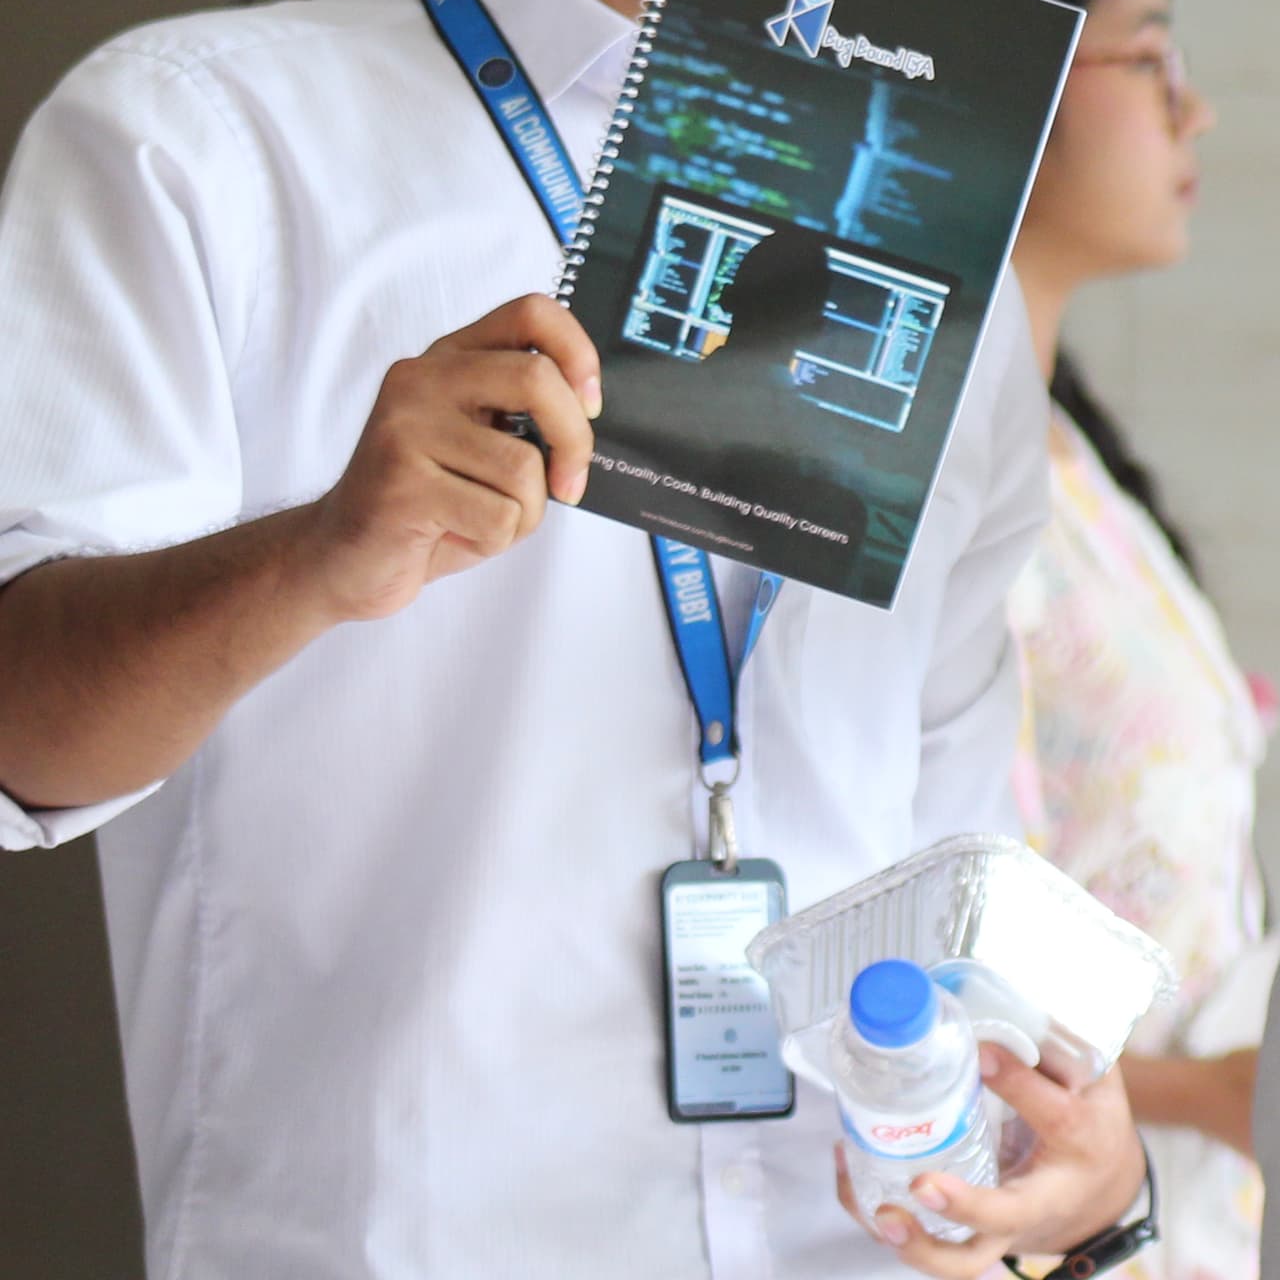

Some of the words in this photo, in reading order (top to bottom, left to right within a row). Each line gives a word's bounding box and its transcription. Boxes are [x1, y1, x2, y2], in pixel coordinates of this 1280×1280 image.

[822, 24, 856, 68] Bug
[853, 33, 906, 70] Bound
[500, 96, 529, 118] AI
[512, 113, 585, 225] COMMUNITY
[615, 460, 661, 485] Quality
[700, 487, 752, 516] Building
[752, 504, 799, 530] Quality
[799, 519, 849, 545] Careers
[672, 569, 713, 624] BUBT
